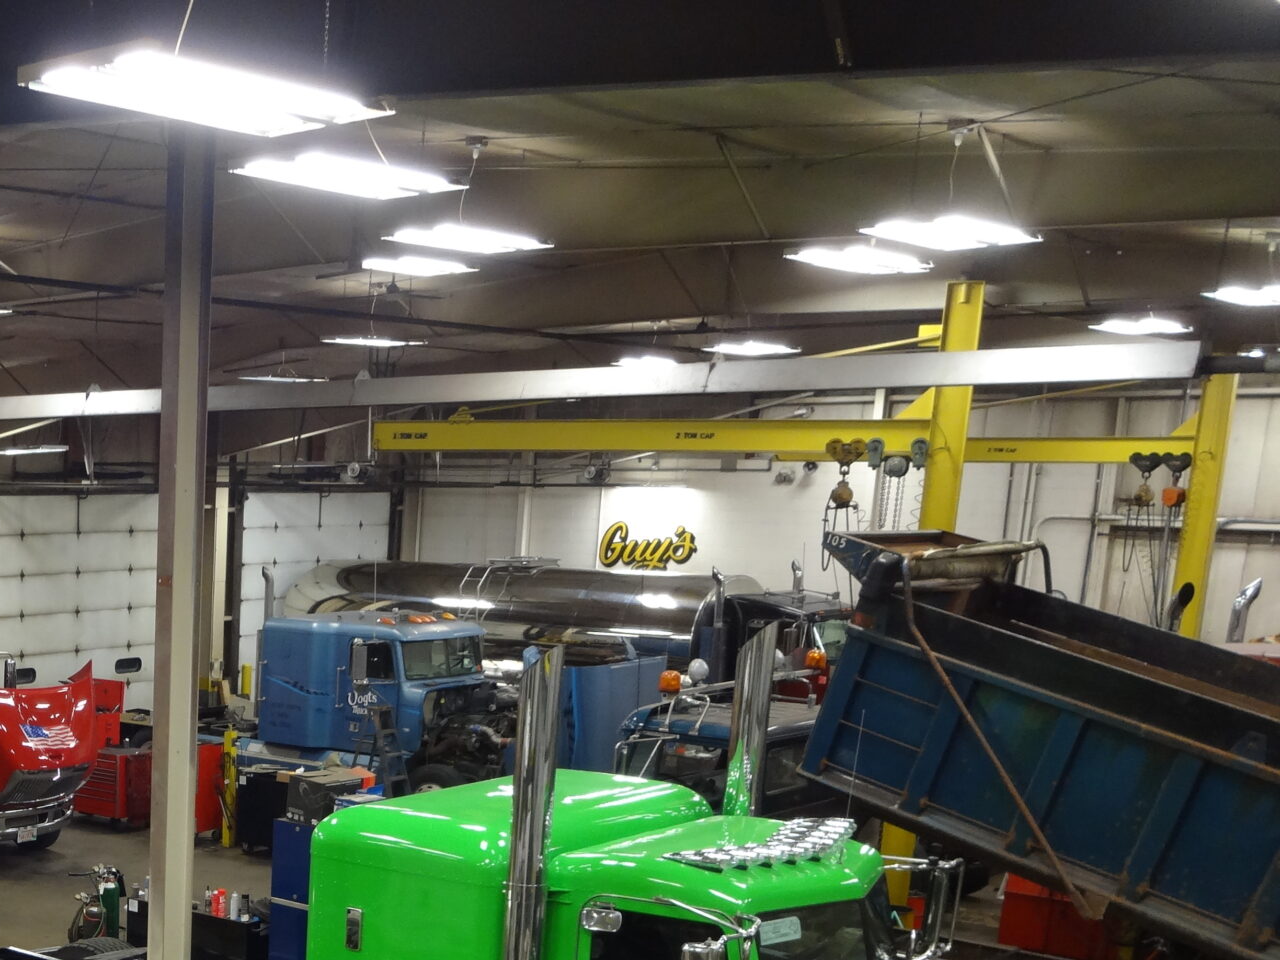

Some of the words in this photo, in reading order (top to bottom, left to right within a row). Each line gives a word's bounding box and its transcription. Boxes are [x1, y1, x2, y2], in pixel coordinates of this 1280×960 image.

[700, 432, 715, 440] CAP
[599, 520, 698, 571] Guy's
[826, 533, 848, 548] 105
